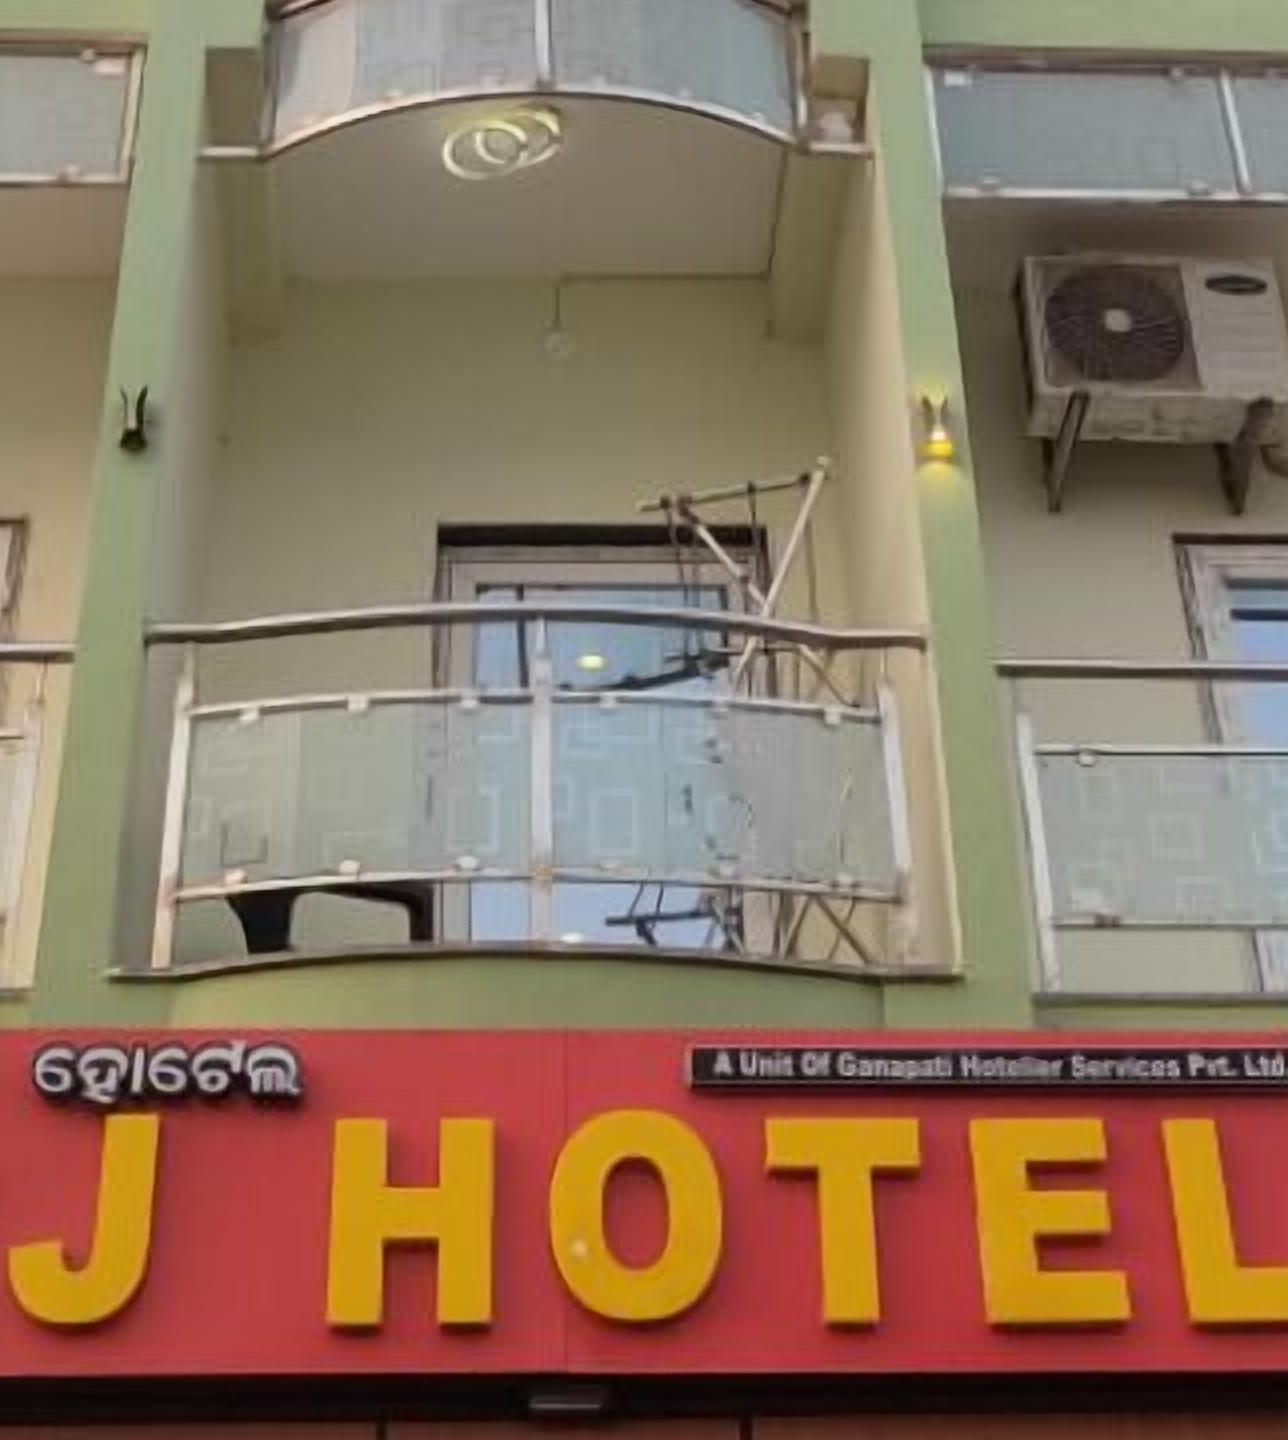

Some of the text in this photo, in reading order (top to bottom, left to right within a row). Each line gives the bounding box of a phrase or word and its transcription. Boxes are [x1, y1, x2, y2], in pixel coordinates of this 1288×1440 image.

[713, 1050, 733, 1077] A
[739, 1050, 795, 1077] Unit
[801, 1050, 831, 1077] Of
[836, 1050, 953, 1080] Ganapati
[1070, 1054, 1181, 1078] Services
[1187, 1053, 1237, 1078] Pvt.
